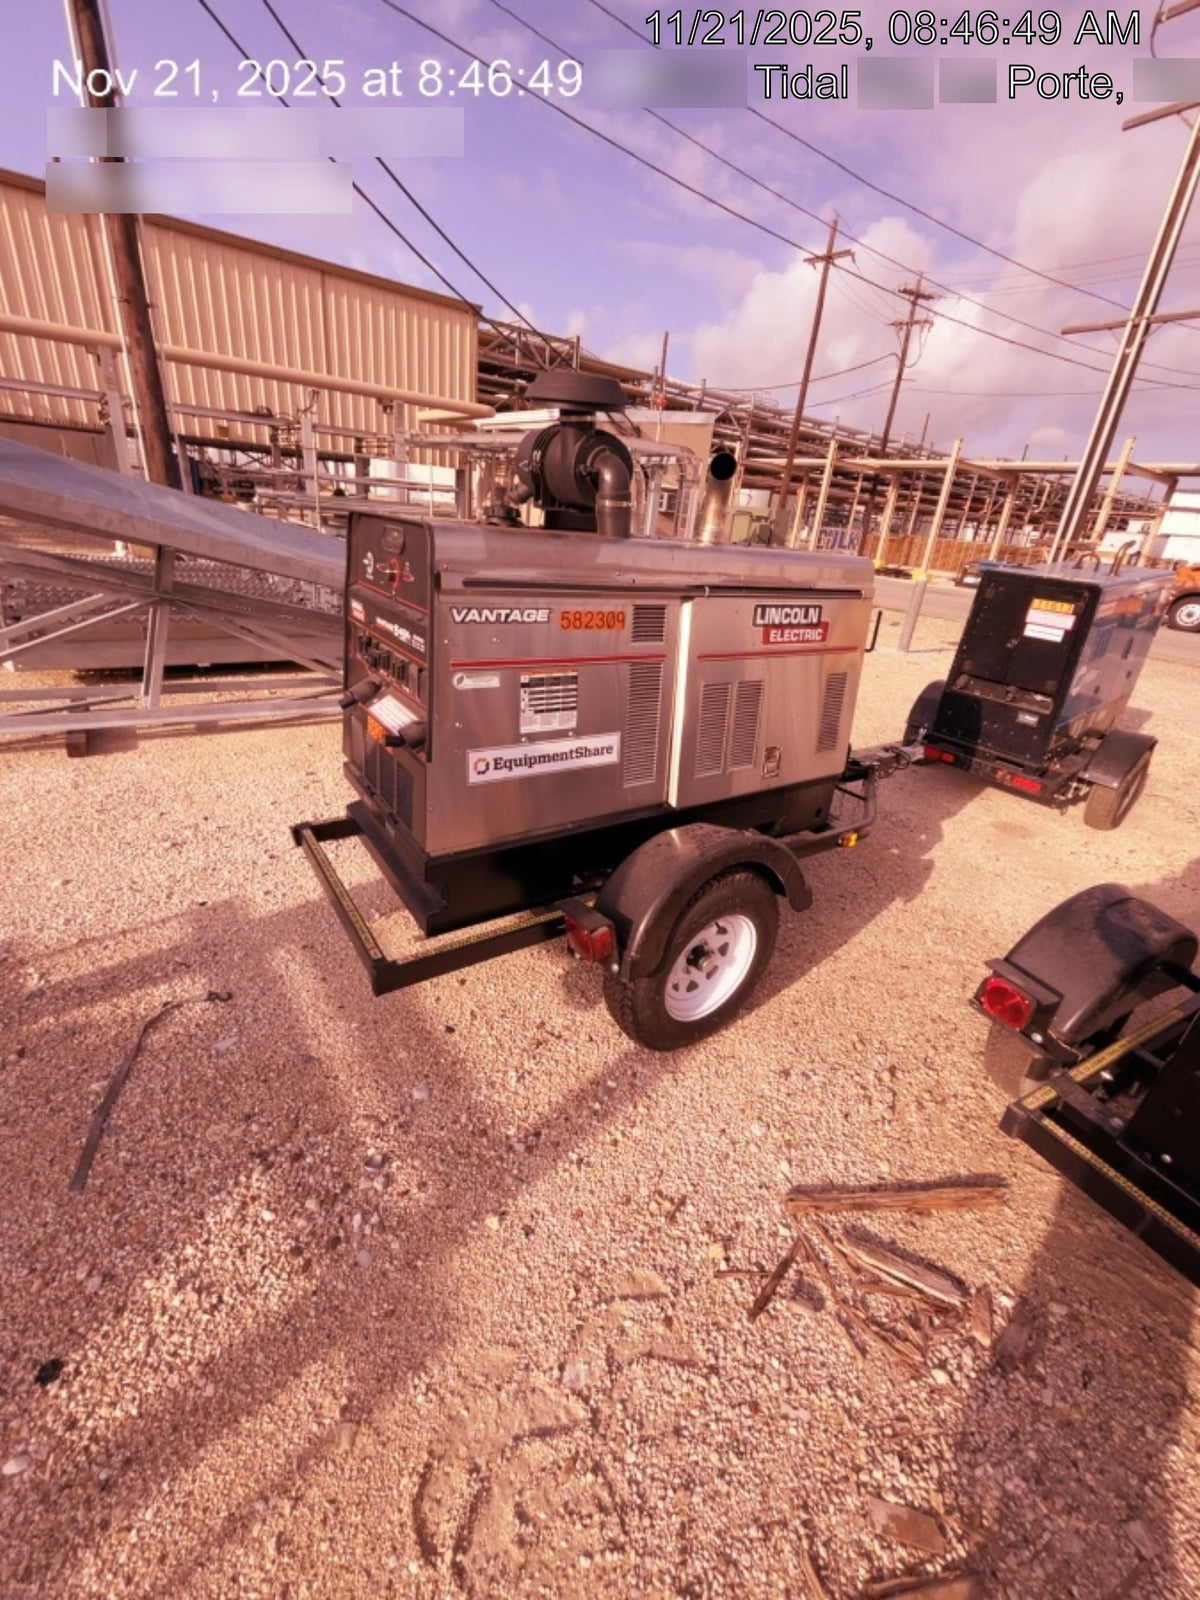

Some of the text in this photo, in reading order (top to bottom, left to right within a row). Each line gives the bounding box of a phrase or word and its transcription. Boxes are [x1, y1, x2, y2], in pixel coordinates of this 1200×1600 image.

[451, 608, 550, 624] VANTAGE
[561, 611, 626, 629] 582309
[755, 606, 820, 625] LINCOLN
[769, 628, 823, 642] ELECTRIC
[492, 744, 614, 772] EquipmentShare
